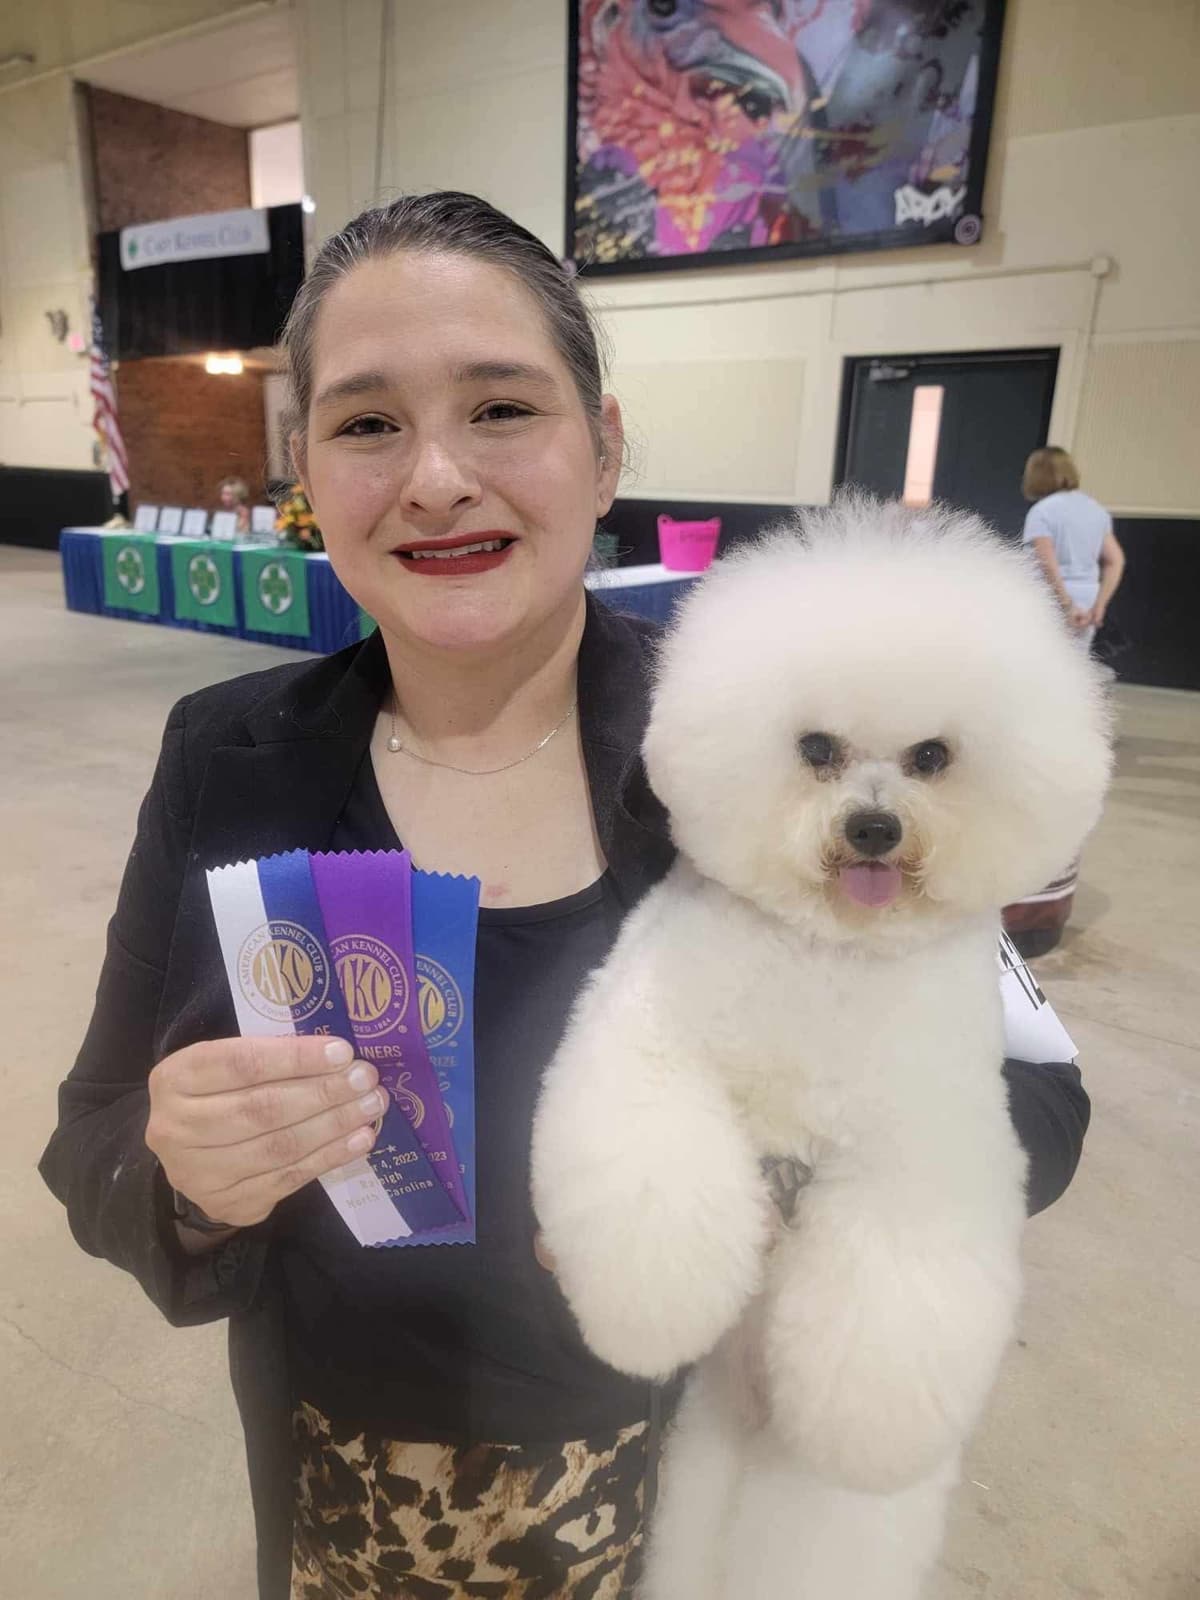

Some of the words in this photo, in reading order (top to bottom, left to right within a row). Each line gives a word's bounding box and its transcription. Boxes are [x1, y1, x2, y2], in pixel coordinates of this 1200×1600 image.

[268, 926, 306, 945] KENNEL
[306, 943, 323, 972] CLUB
[352, 941, 390, 967] KENNEL
[389, 962, 403, 996] CLUB
[258, 943, 311, 1002] AKC
[416, 960, 449, 988] ENNEL
[444, 989, 457, 1017] CLUB
[429, 1055, 456, 1067] RIZE
[392, 1151, 418, 1166] 2023
[386, 1180, 433, 1197] Carolina
